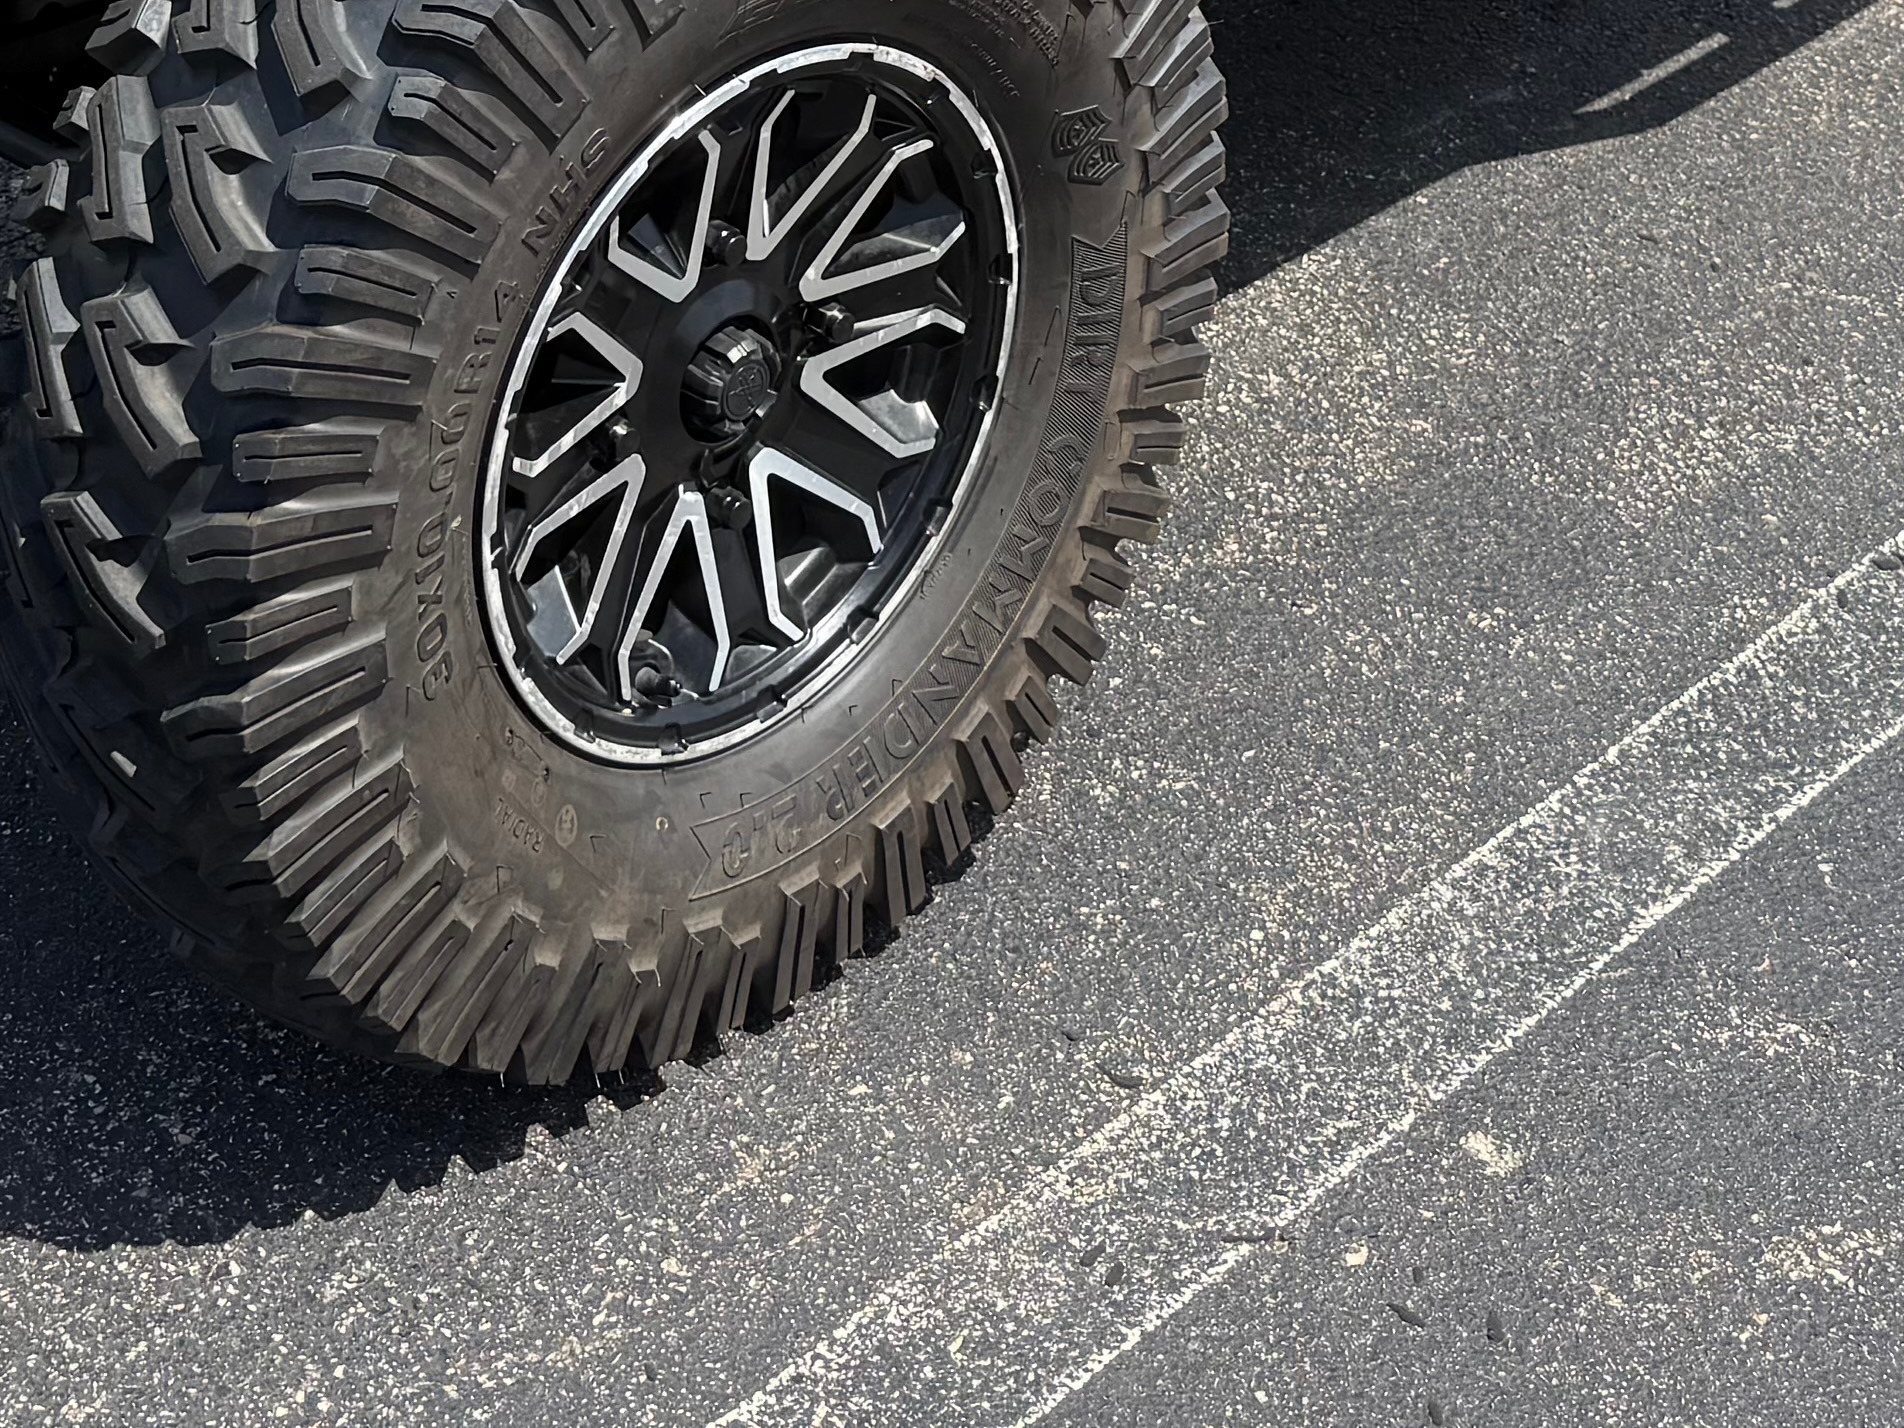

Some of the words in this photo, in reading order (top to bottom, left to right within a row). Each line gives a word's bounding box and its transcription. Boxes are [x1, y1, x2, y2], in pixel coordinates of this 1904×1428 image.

[521, 127, 610, 259] NHS
[1063, 261, 1125, 400] DIRT
[815, 433, 1085, 823] COMMANDER
[495, 796, 544, 853] RADIAL
[721, 796, 798, 880] 2.0
